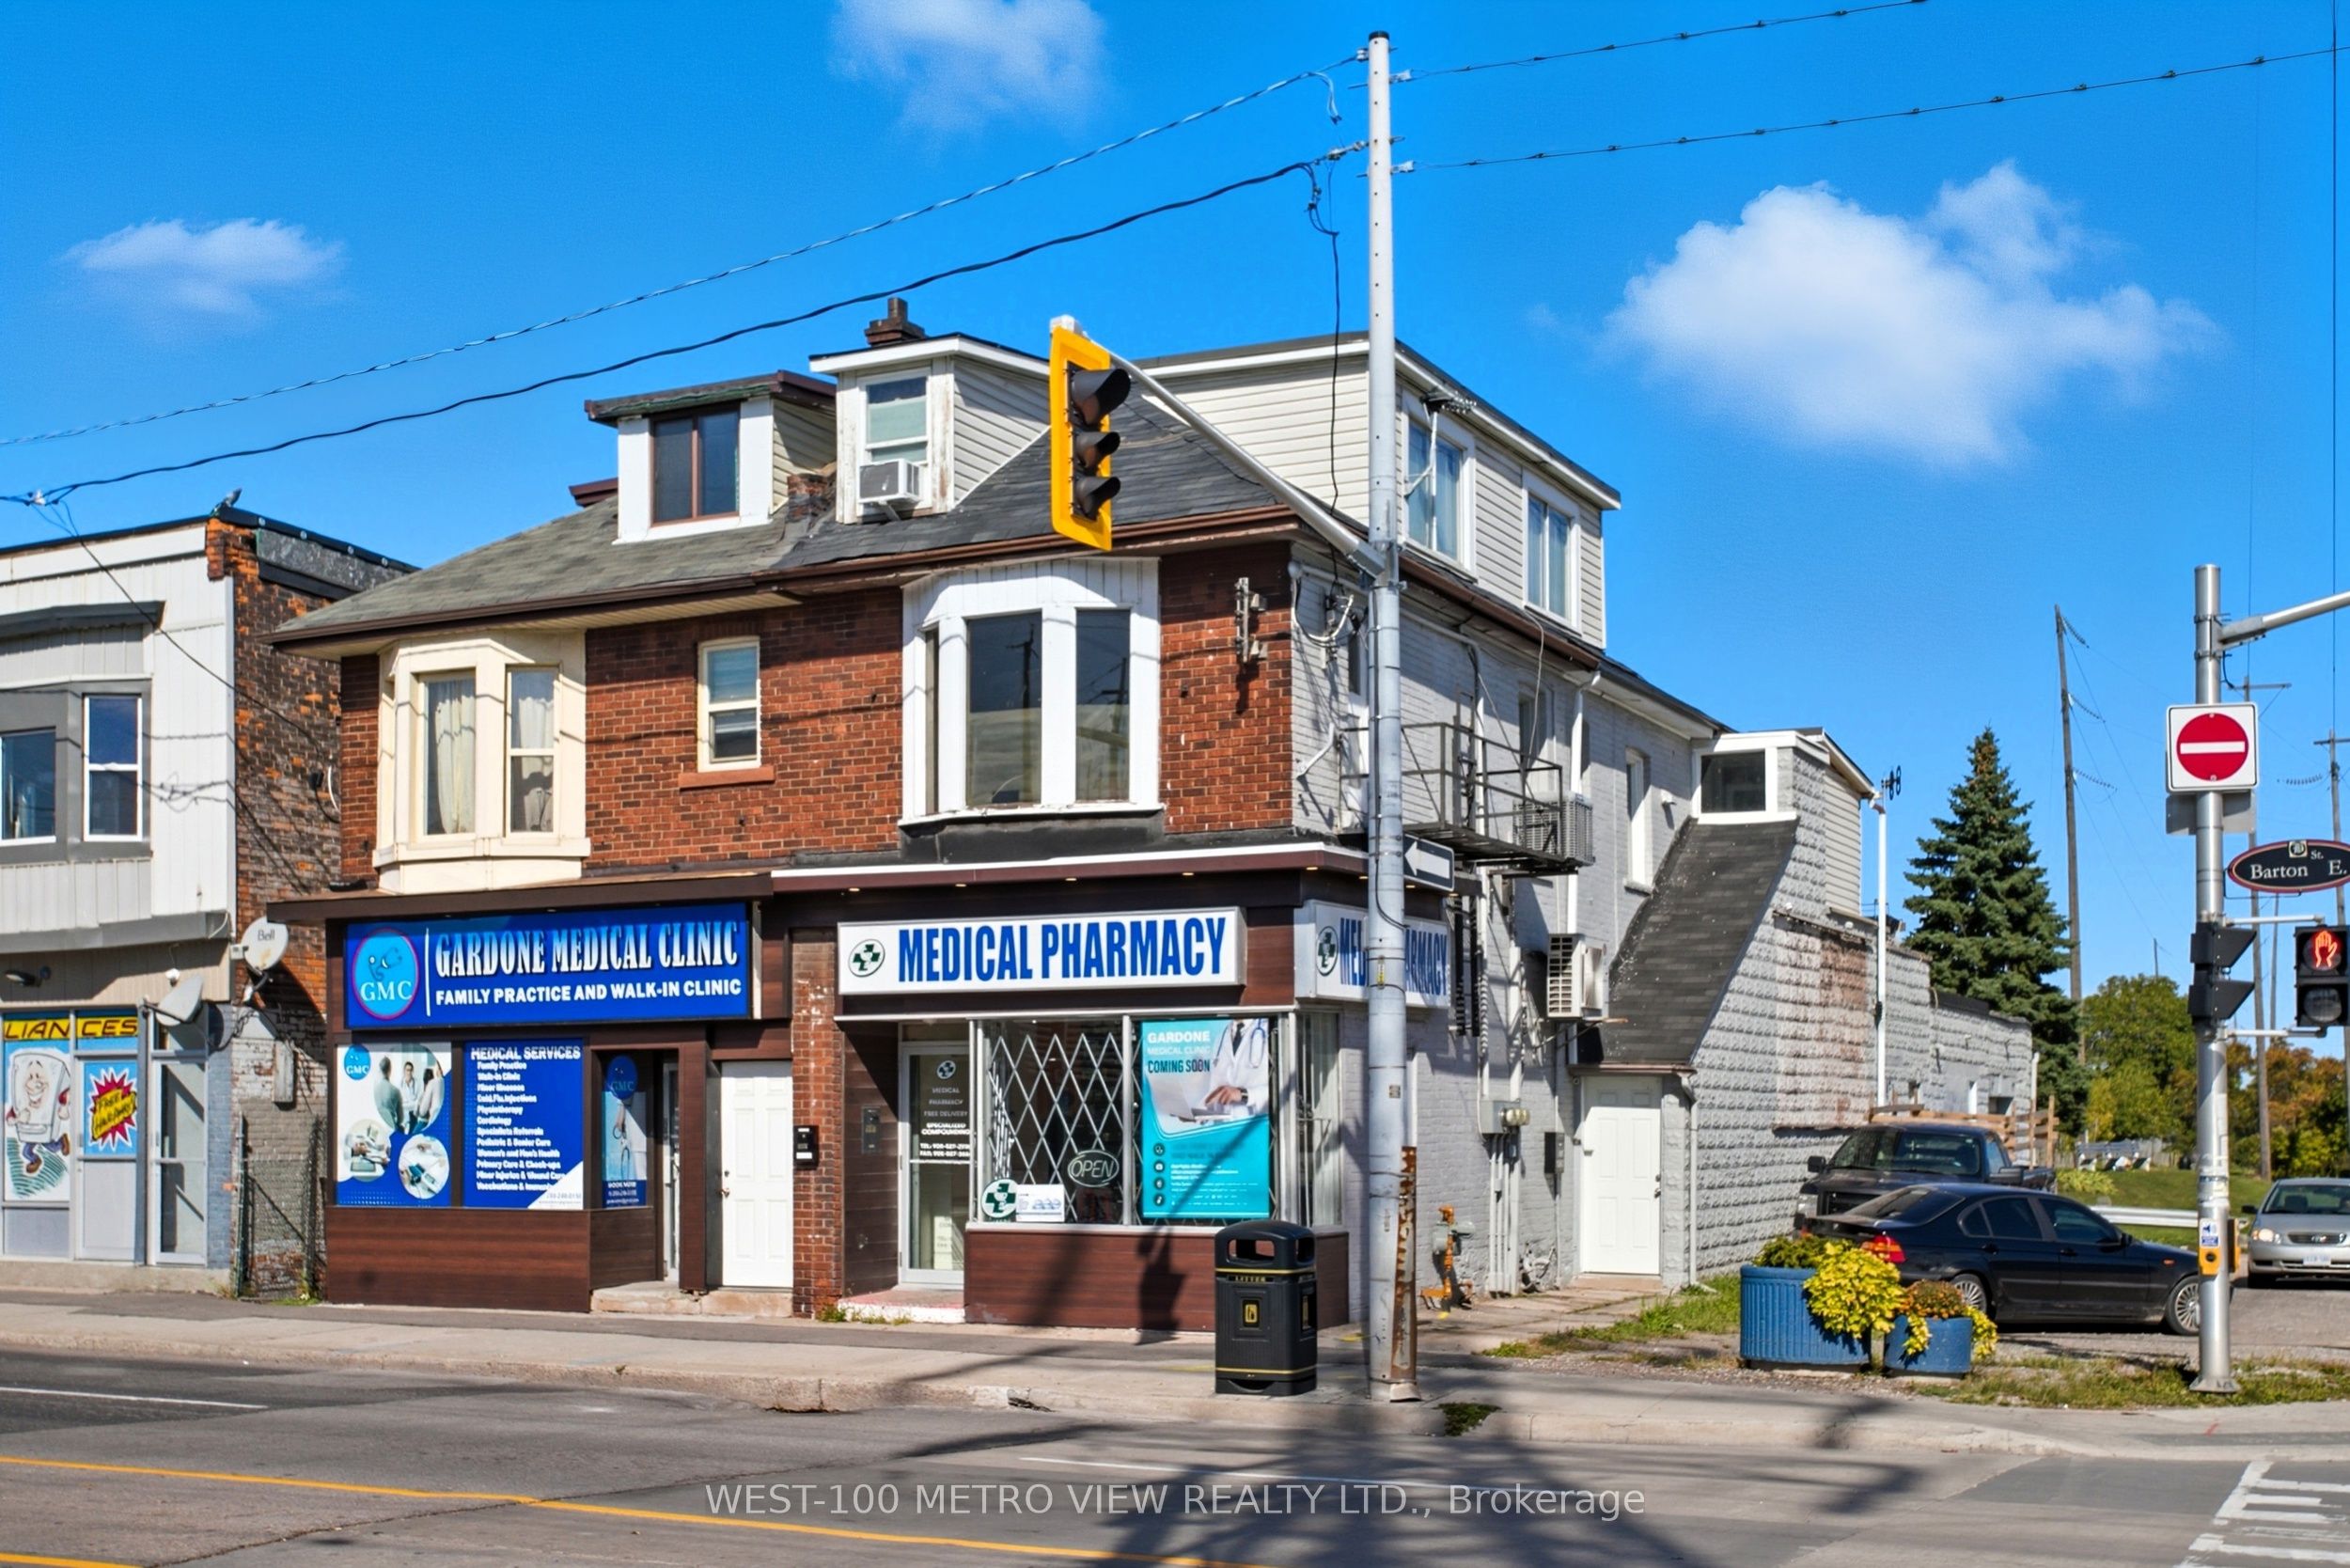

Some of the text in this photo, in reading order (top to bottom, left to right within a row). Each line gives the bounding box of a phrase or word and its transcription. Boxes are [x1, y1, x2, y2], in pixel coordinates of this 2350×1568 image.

[2250, 850, 2347, 880] Barton St. E.
[258, 929, 275, 941] Bell
[435, 921, 738, 978] GARDONE MEDICAL CLINIC
[898, 917, 1227, 982] MEDICAL PHARMACY
[1404, 928, 1448, 996] ARMACY
[360, 980, 413, 1002] GMC
[435, 979, 742, 1006] FAMILY PRACTICE AND WALK-IN CLINIC
[1147, 1030, 1211, 1043] GARDONE
[471, 1045, 581, 1060] MEDICAL SERVICES
[1147, 1046, 1183, 1055] MEDICAL
[346, 1065, 370, 1074] GMC
[1148, 1059, 1211, 1074] COMING SOON
[1072, 1160, 1114, 1178] OPEN
